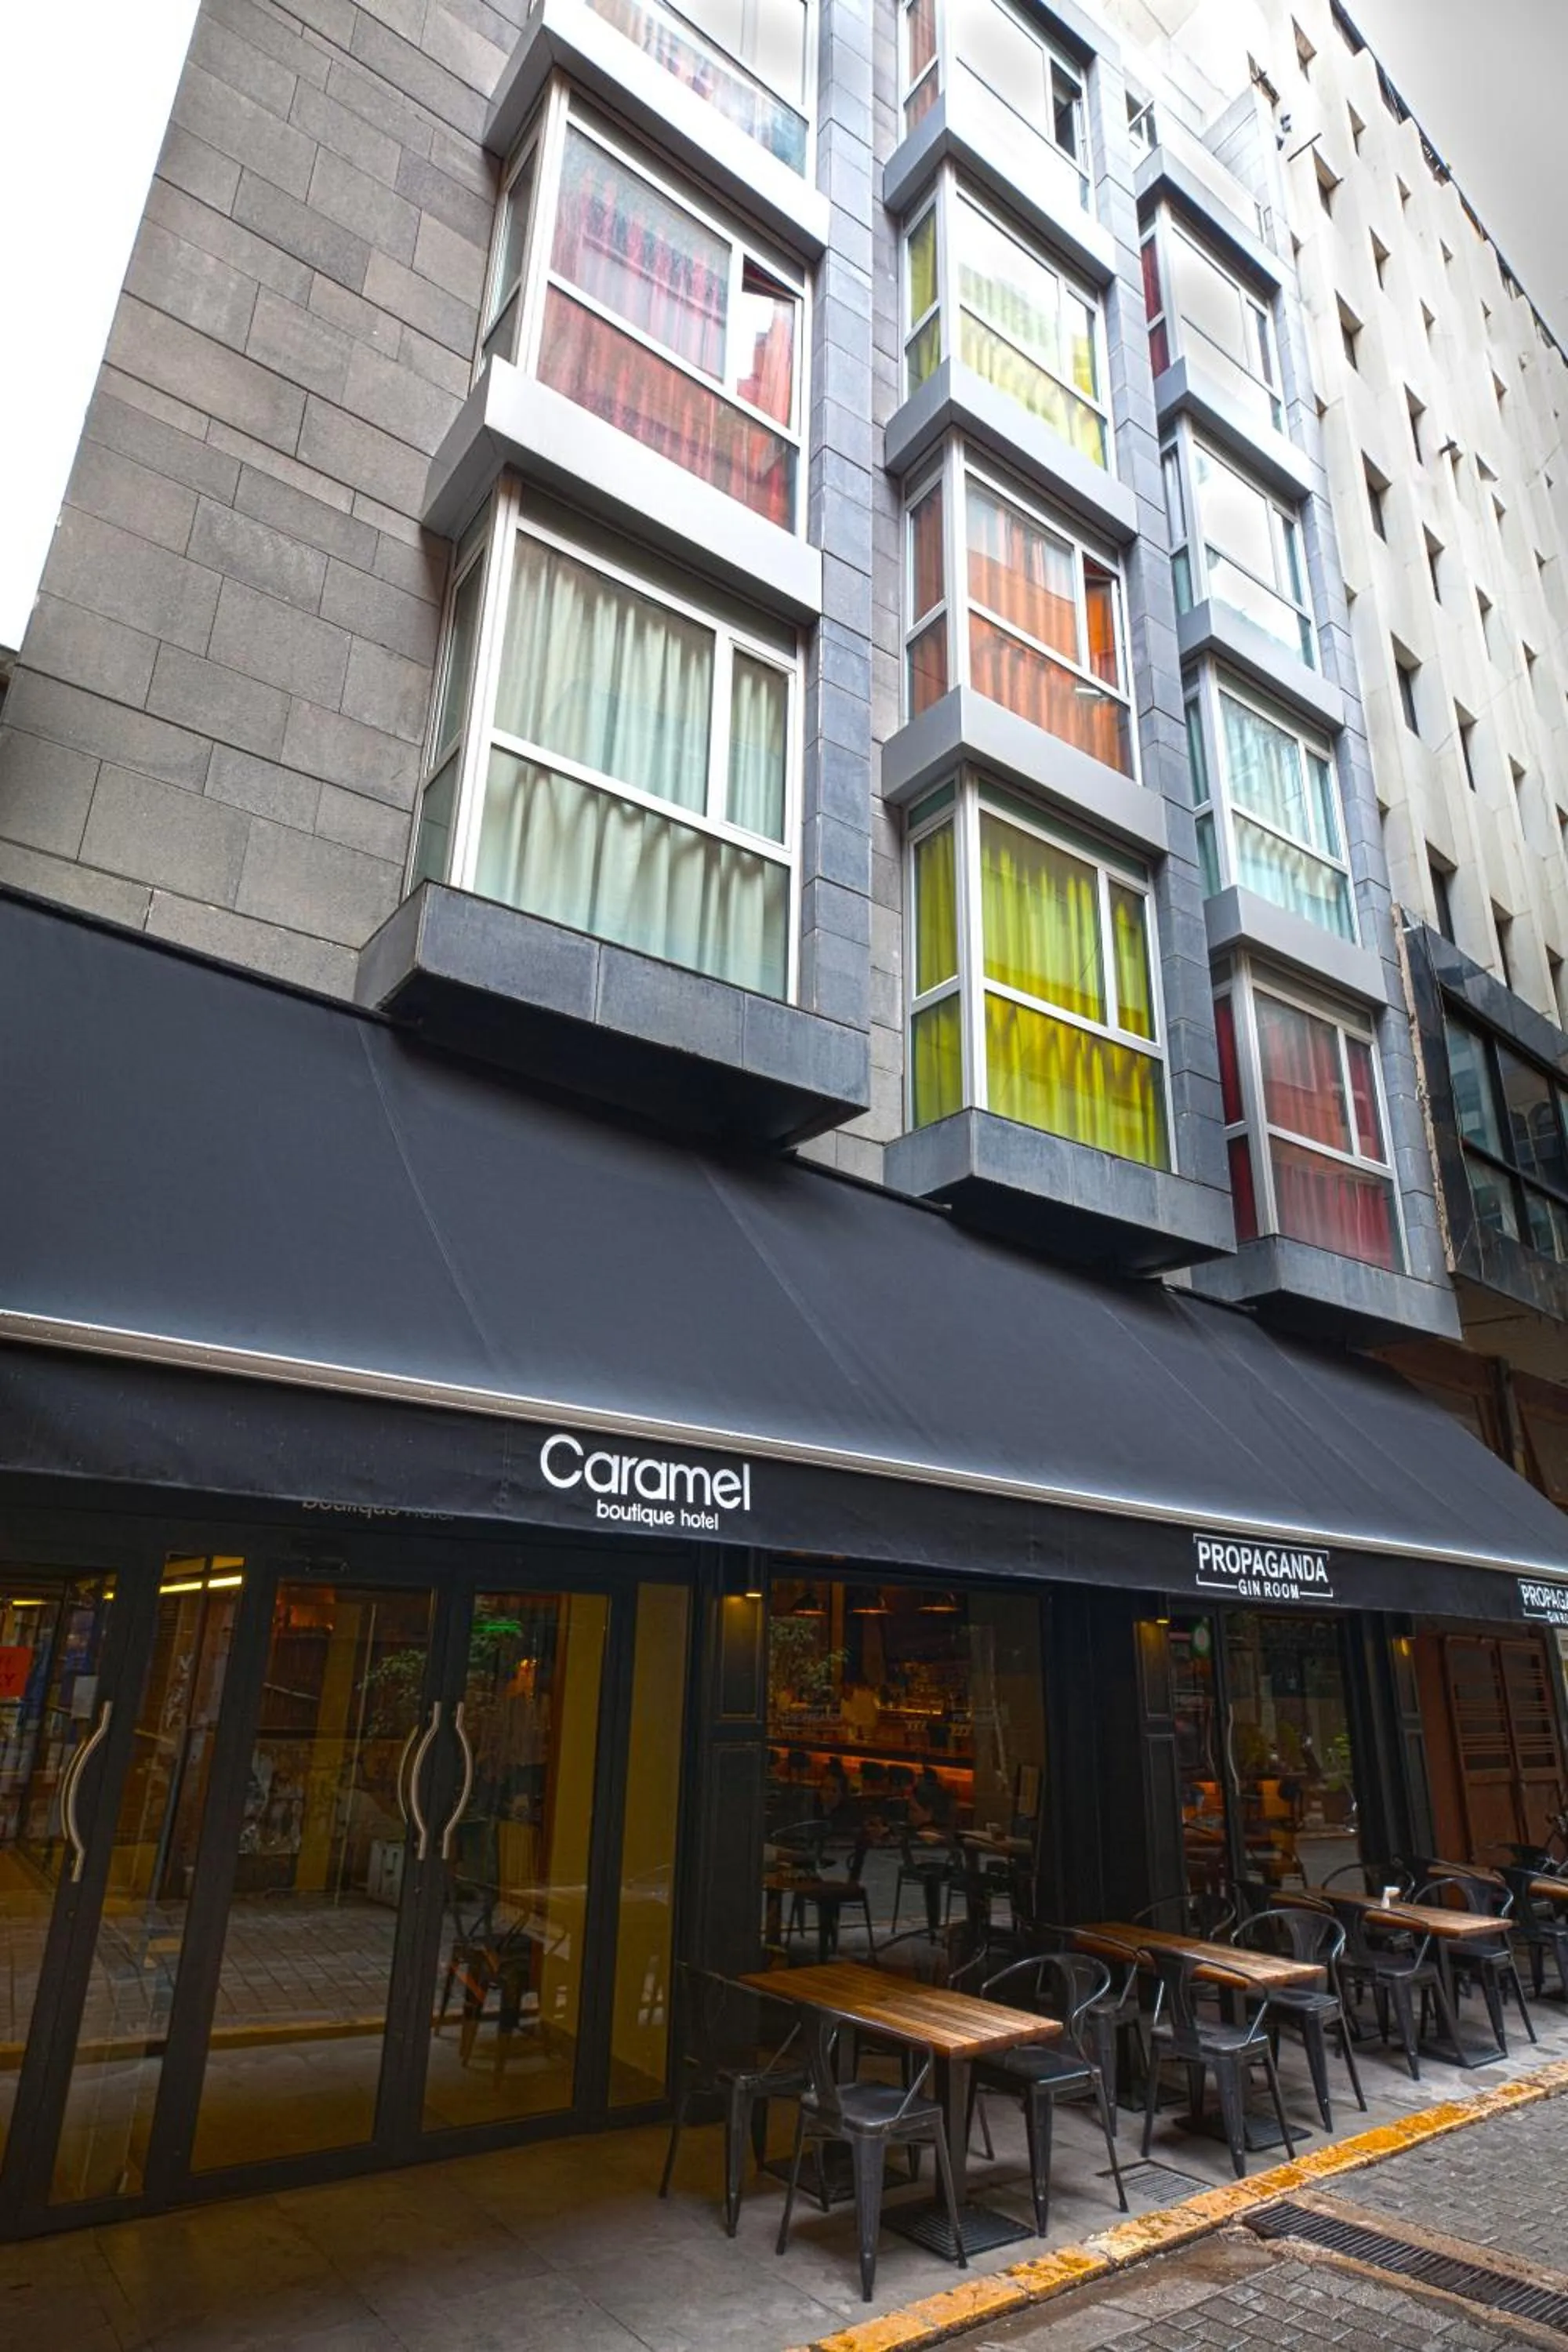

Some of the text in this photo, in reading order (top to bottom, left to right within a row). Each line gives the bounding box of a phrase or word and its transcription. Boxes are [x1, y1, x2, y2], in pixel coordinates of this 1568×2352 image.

[540, 1433, 750, 1510] Caramel
[597, 1499, 719, 1530] boutique hotel
[1197, 1541, 1329, 1583] PROPAGANDA
[1238, 1578, 1300, 1599] GIN ROOM
